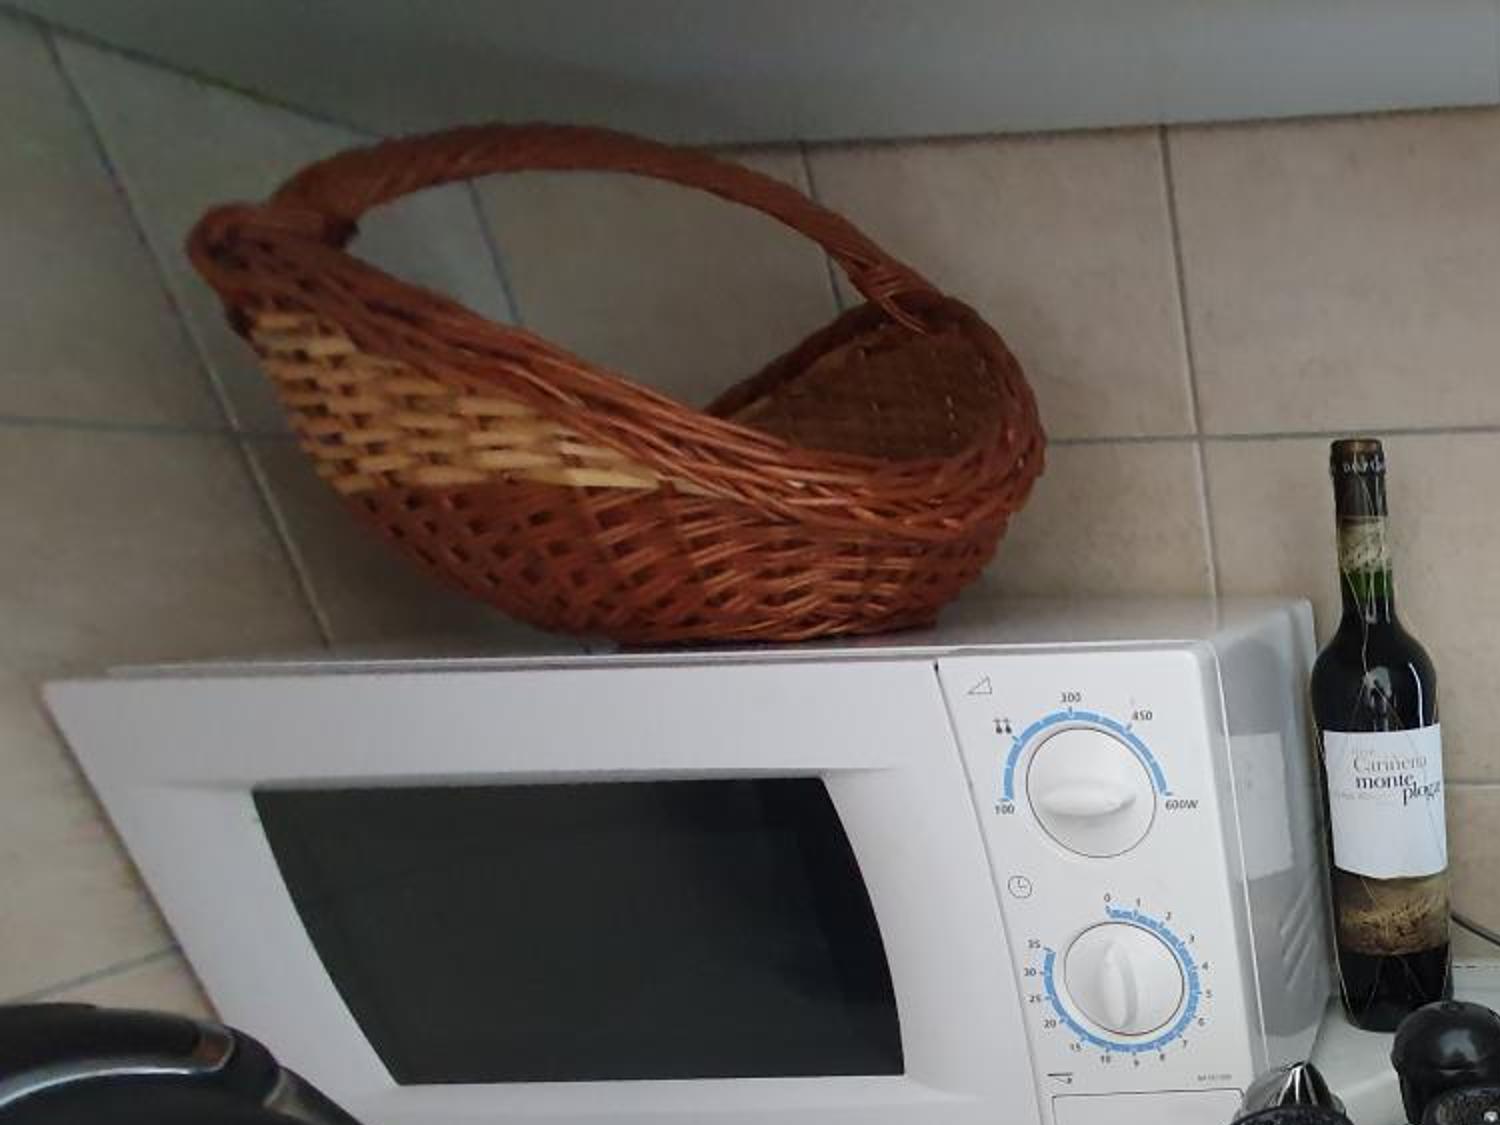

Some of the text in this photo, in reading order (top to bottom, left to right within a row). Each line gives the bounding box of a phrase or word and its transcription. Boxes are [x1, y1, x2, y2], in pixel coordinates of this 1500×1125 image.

[1132, 710, 1153, 721] 450
[1355, 773, 1414, 789] monte
[994, 804, 1015, 814] 100
[1165, 799, 1198, 811] 600W
[1043, 1019, 1057, 1029] 20
